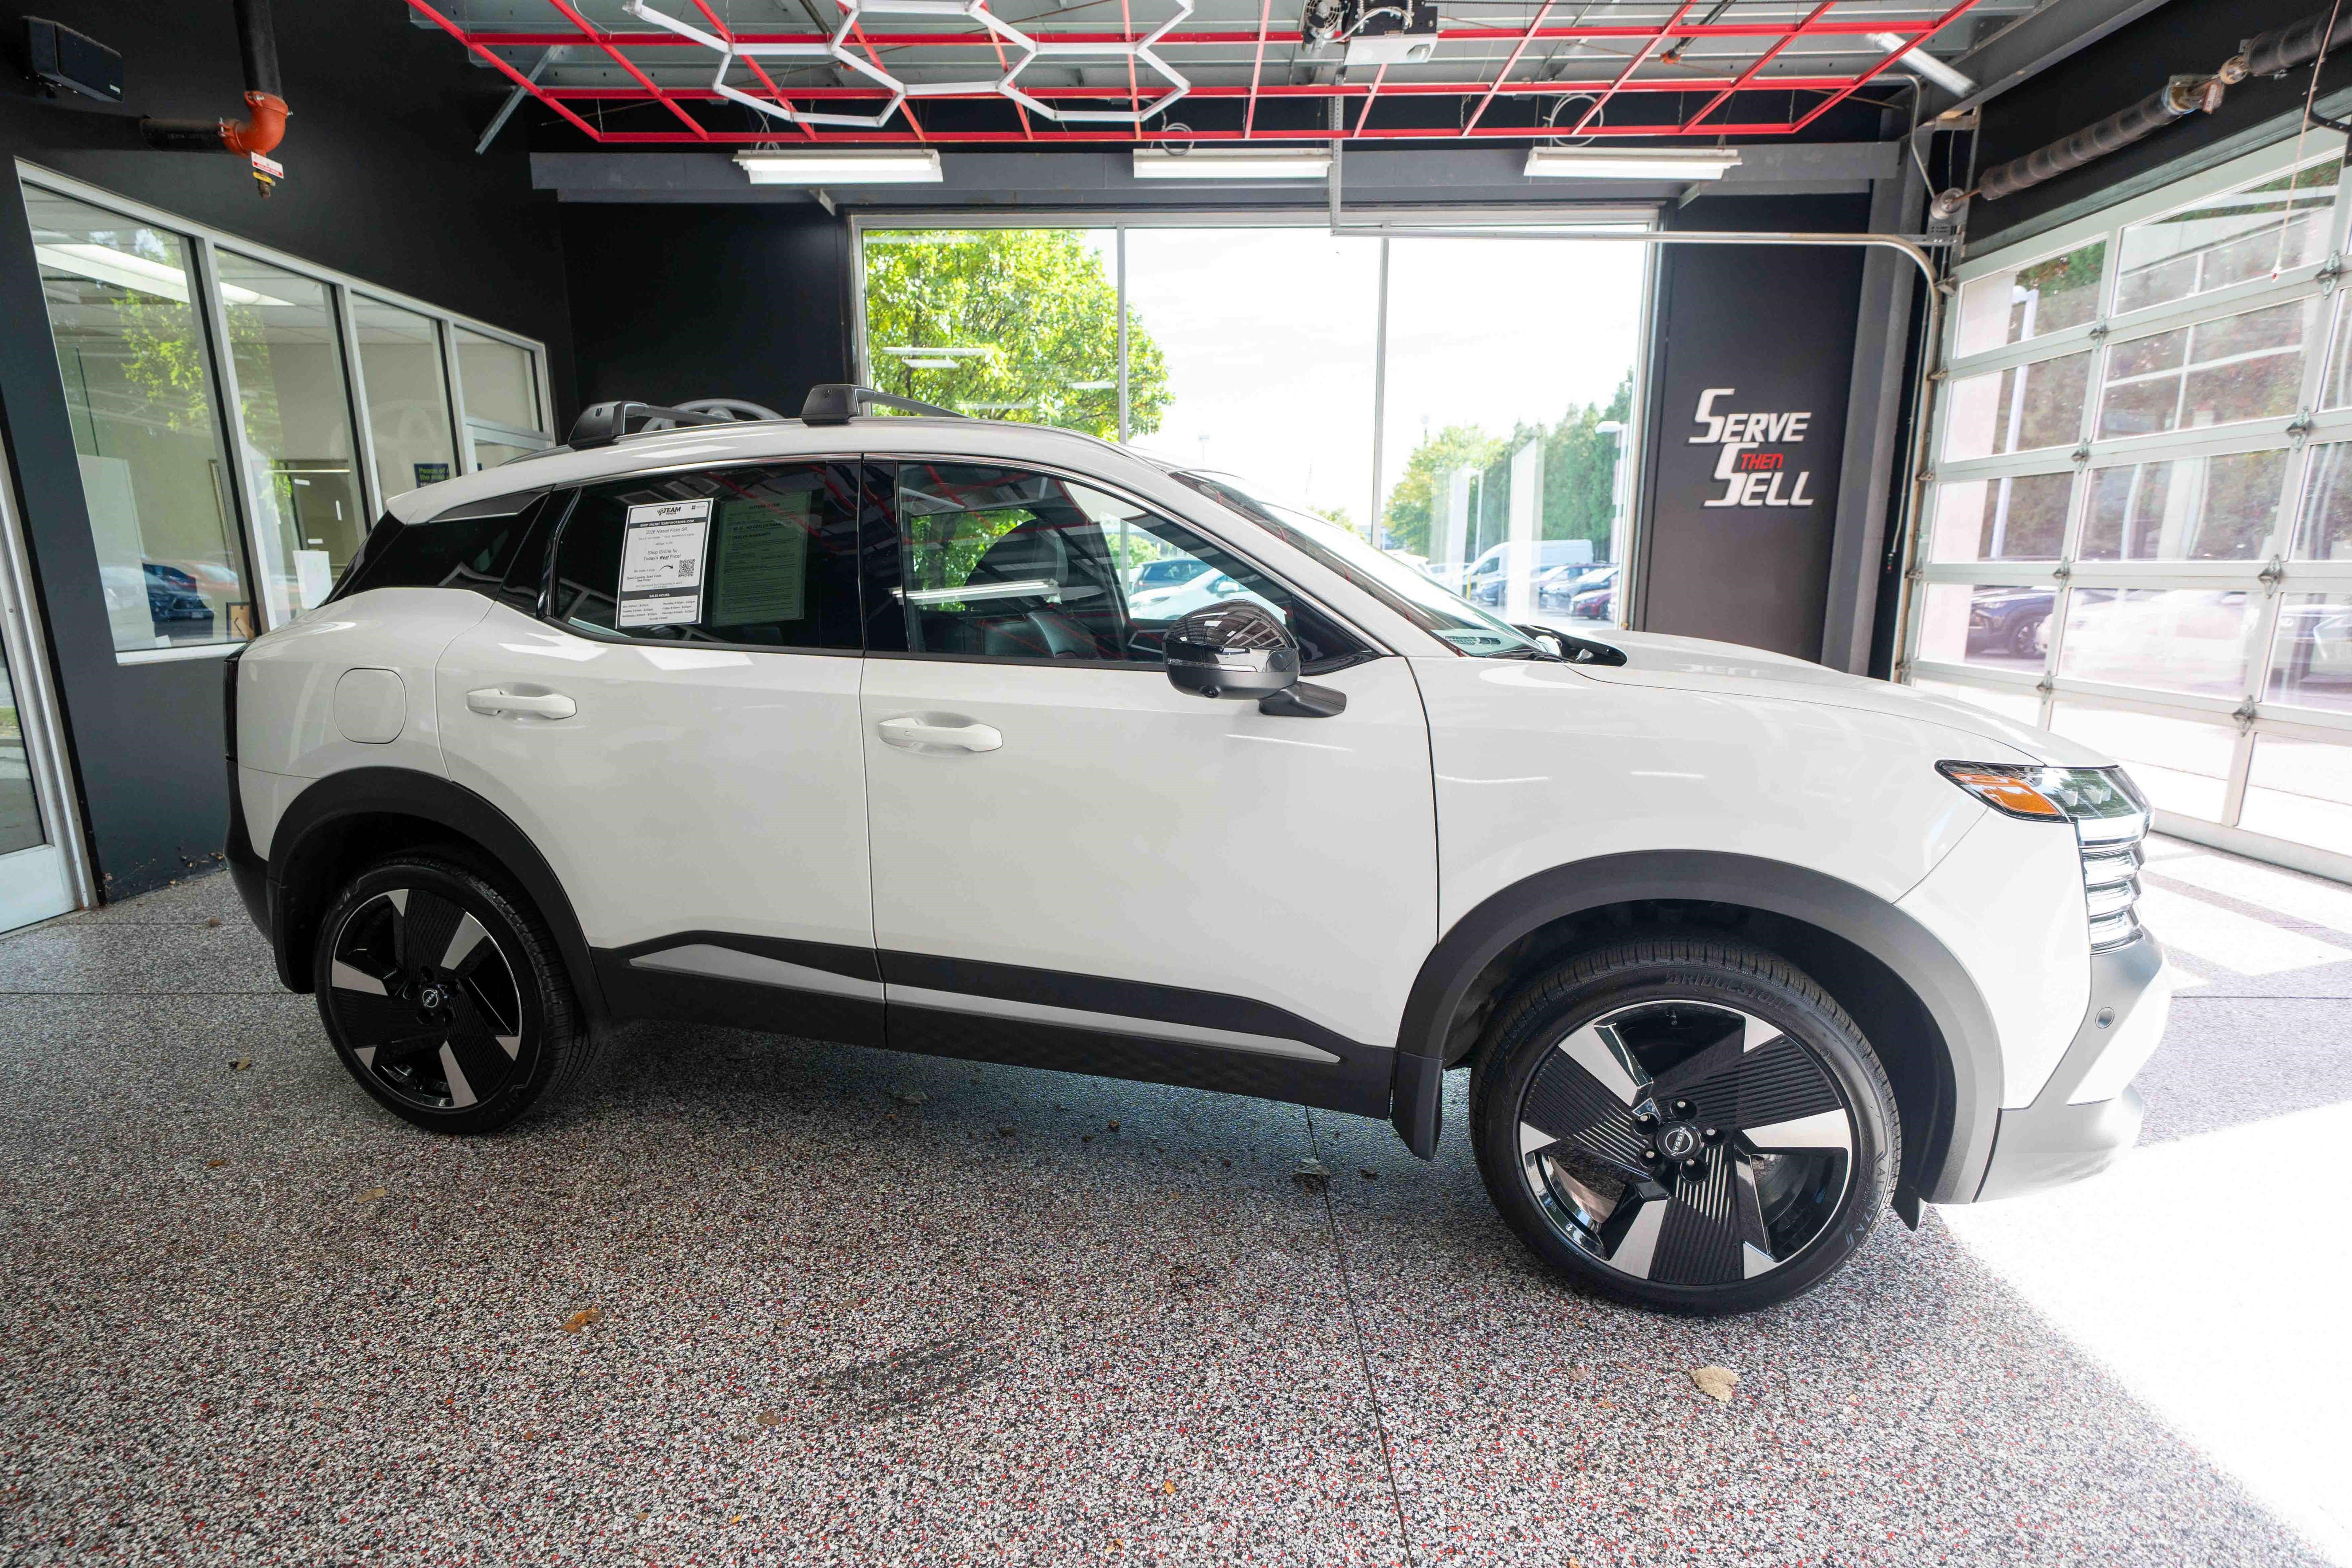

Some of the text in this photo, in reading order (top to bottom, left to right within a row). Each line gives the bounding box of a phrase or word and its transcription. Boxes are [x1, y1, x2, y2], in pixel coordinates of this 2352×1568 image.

[1688, 388, 1812, 443] SERVE
[1703, 442, 1814, 507] SELL
[1741, 453, 1783, 470] THEN
[1670, 1126, 1686, 1156] NISSAN
[1855, 1167, 1886, 1232] ALENZA
